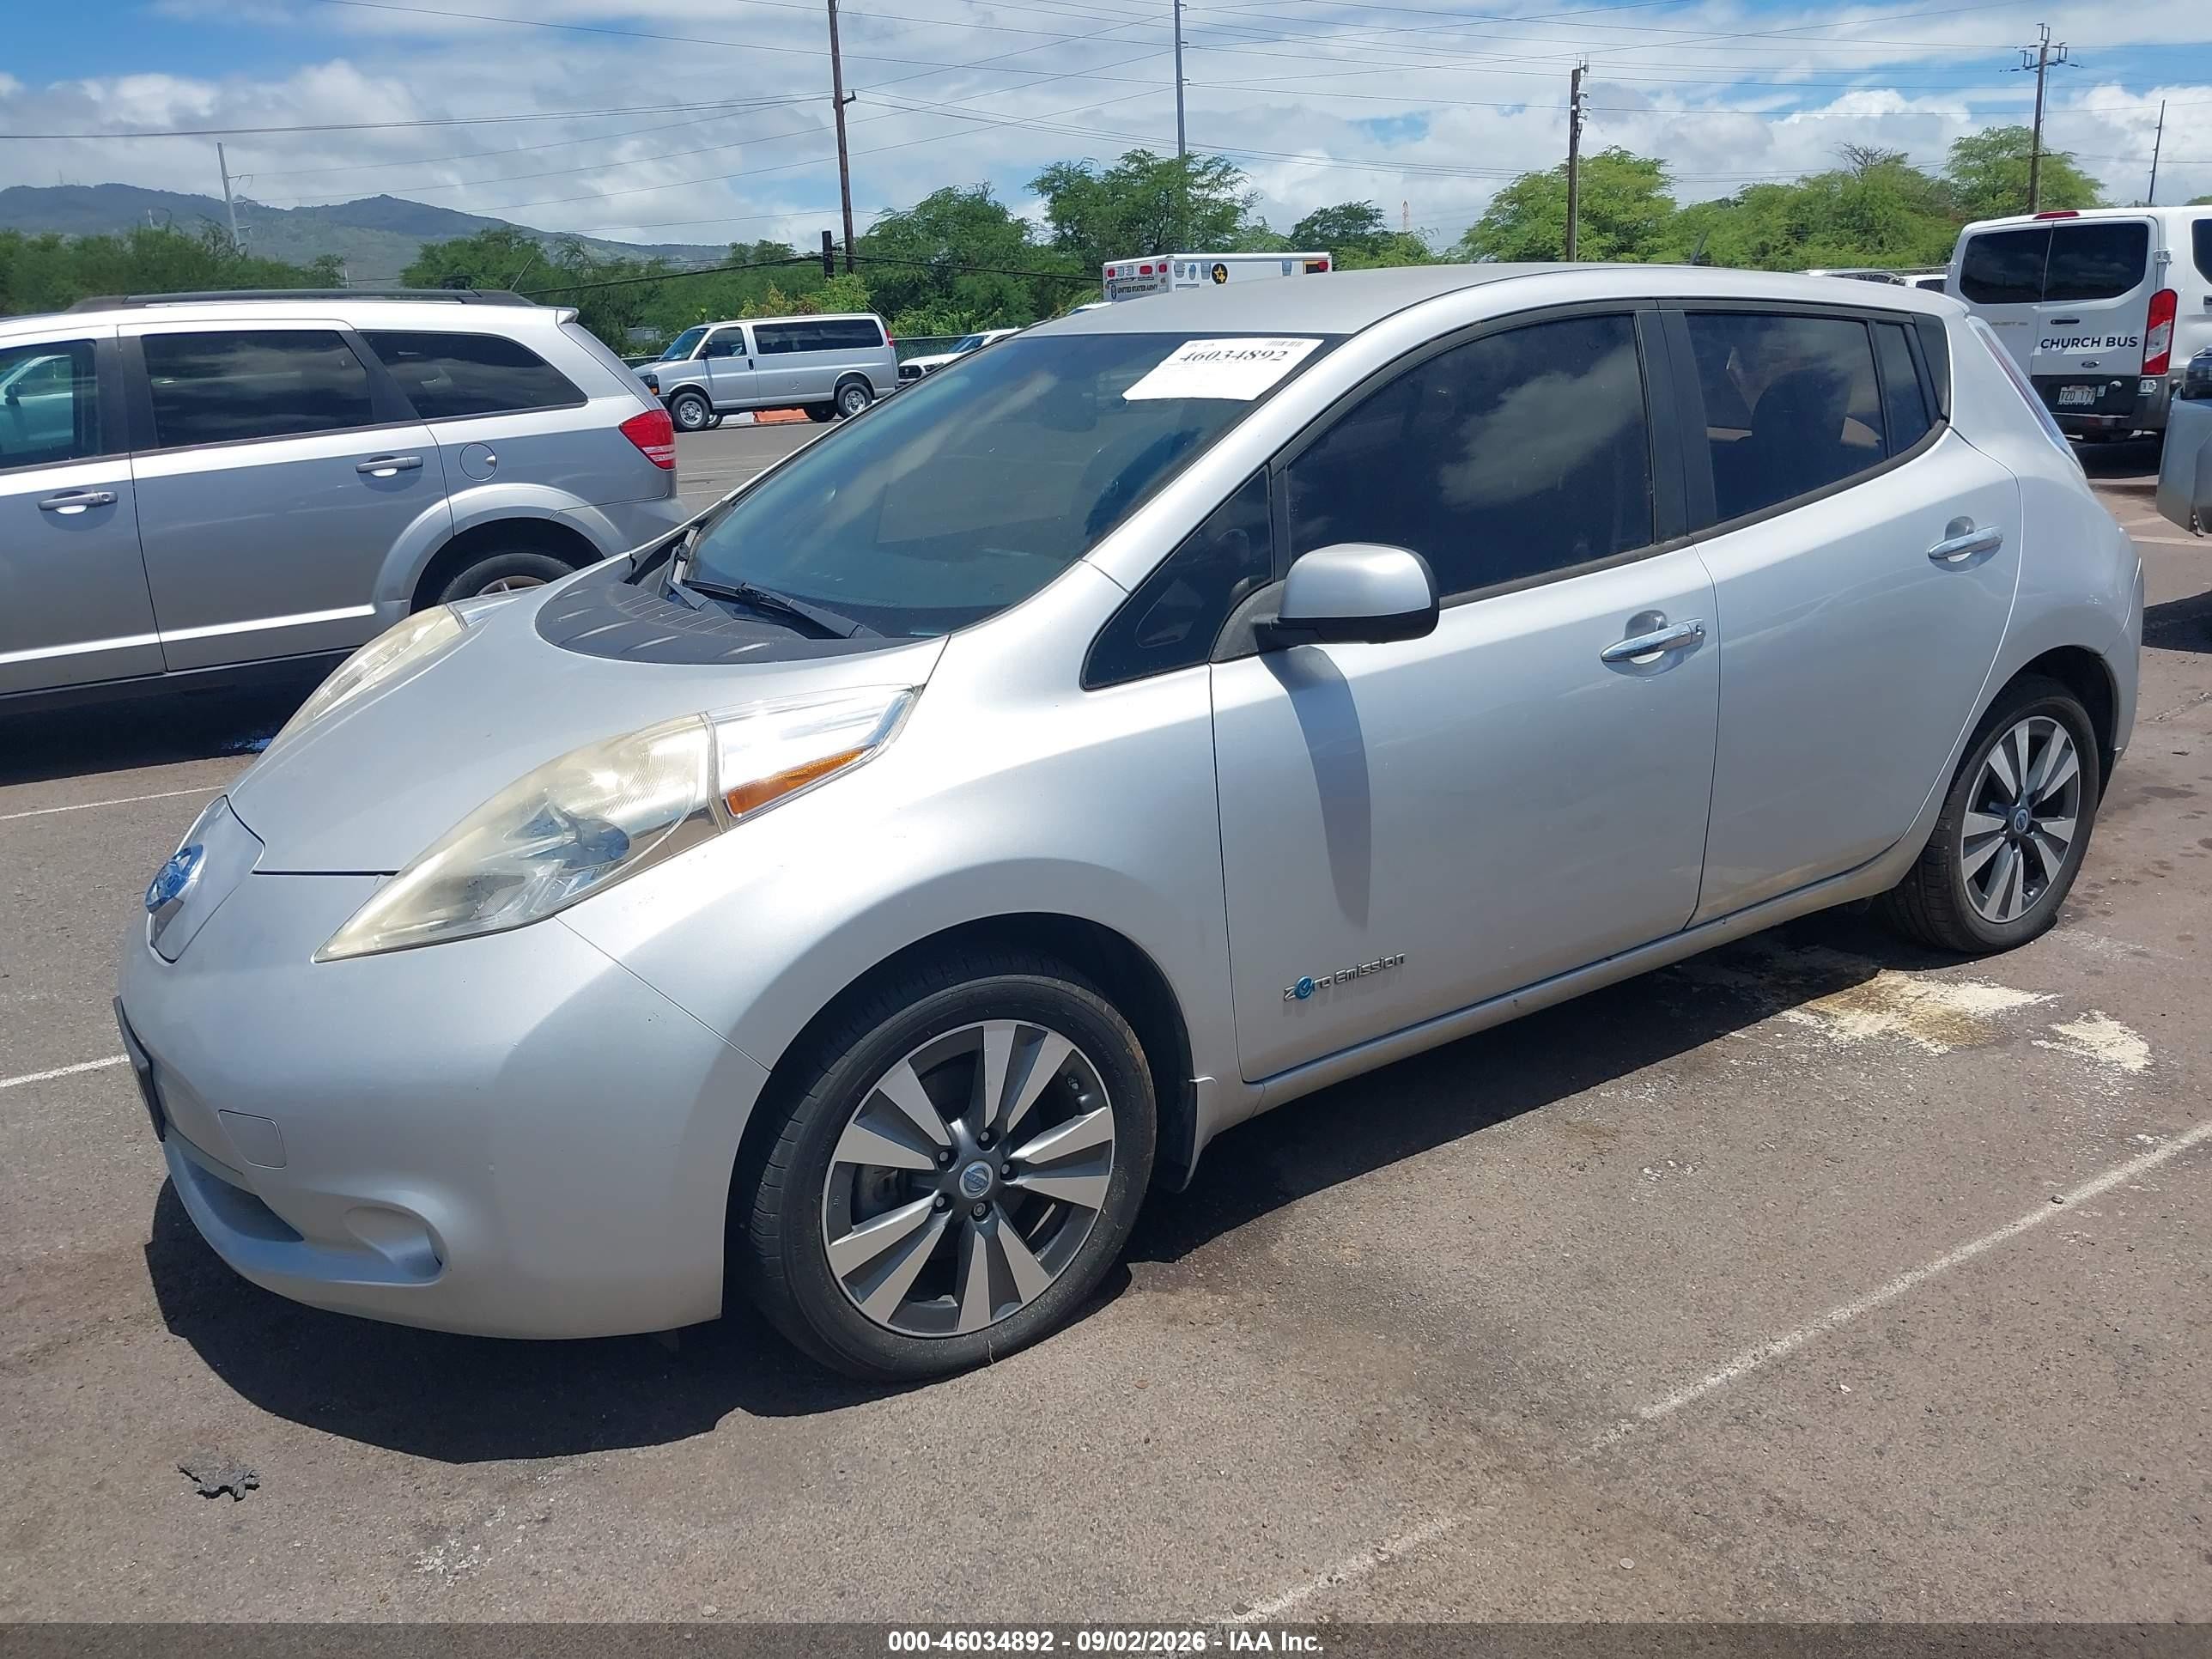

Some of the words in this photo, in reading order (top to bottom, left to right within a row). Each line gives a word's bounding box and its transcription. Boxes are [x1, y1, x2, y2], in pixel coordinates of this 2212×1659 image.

[2040, 337, 2101, 349] CHURCH
[2106, 336, 2138, 348] BUS
[1180, 349, 1289, 362] 46034892
